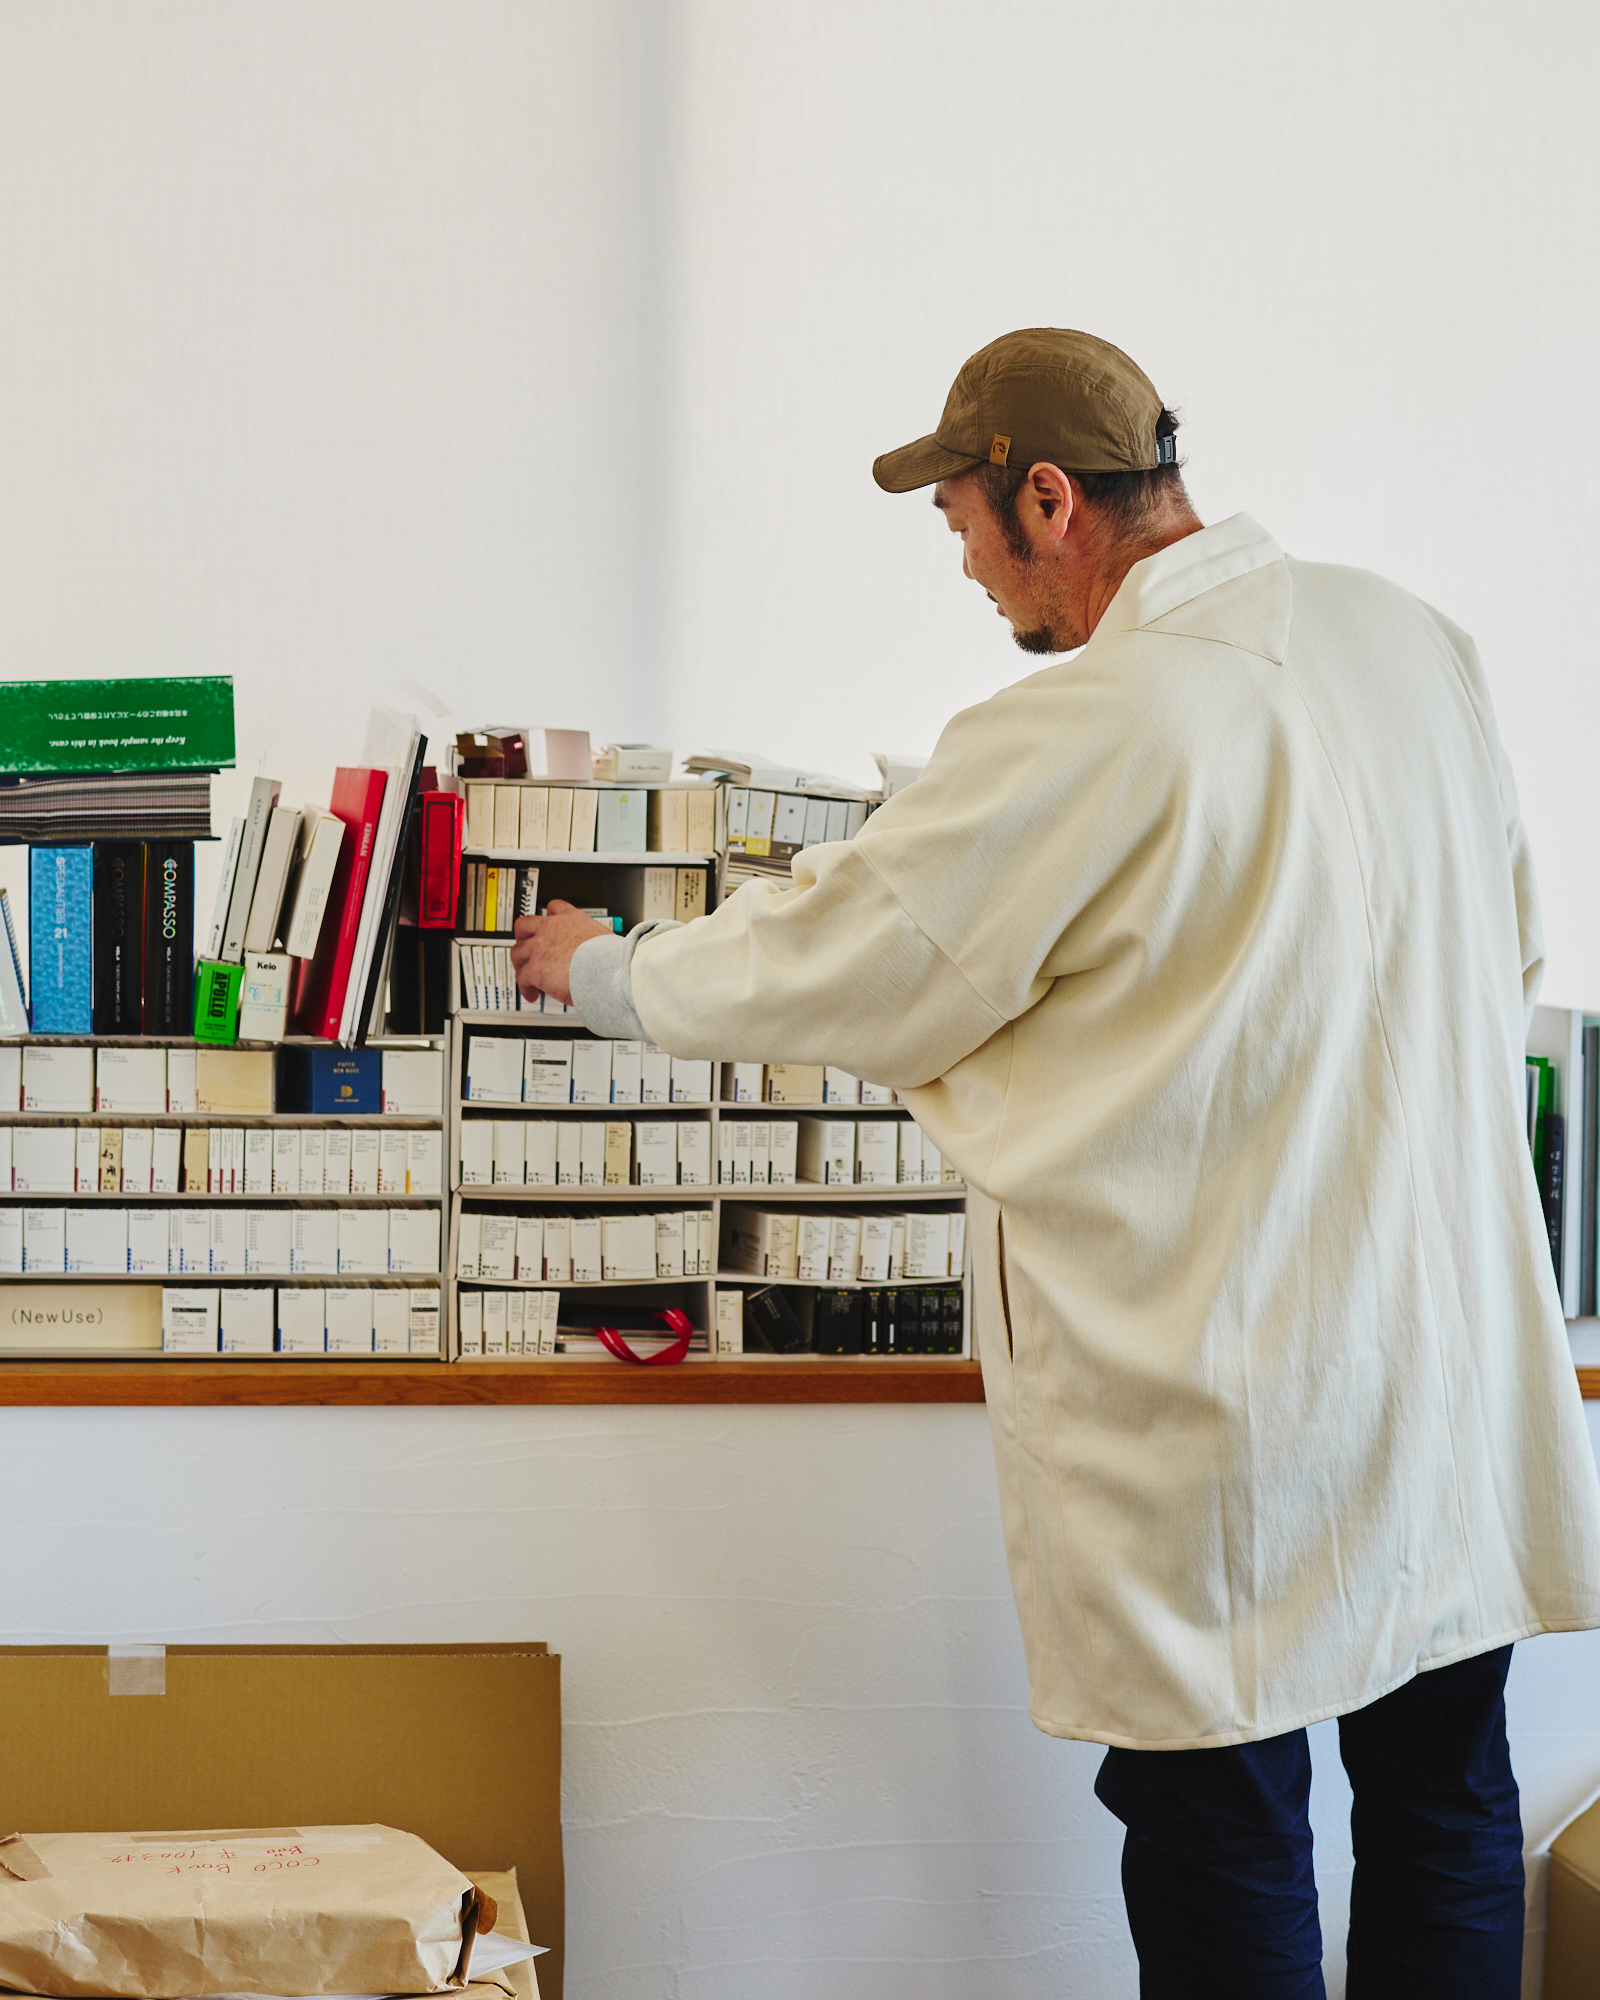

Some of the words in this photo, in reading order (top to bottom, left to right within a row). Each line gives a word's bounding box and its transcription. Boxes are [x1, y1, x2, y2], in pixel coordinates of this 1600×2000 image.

[48, 740, 69, 748] case.
[71, 740, 86, 748] this
[88, 740, 97, 748] in
[99, 739, 118, 748] book
[120, 736, 149, 747] sample
[151, 737, 164, 746] the
[165, 735, 187, 746] Keep
[360, 822, 372, 857] KENRAN
[162, 858, 178, 940] COMPASSO
[54, 927, 68, 939] 21
[257, 961, 277, 971] Keio
[210, 971, 228, 1018] APOLLO
[12, 1308, 103, 1325] (NewUse)
[254, 1857, 320, 1872] COCO
